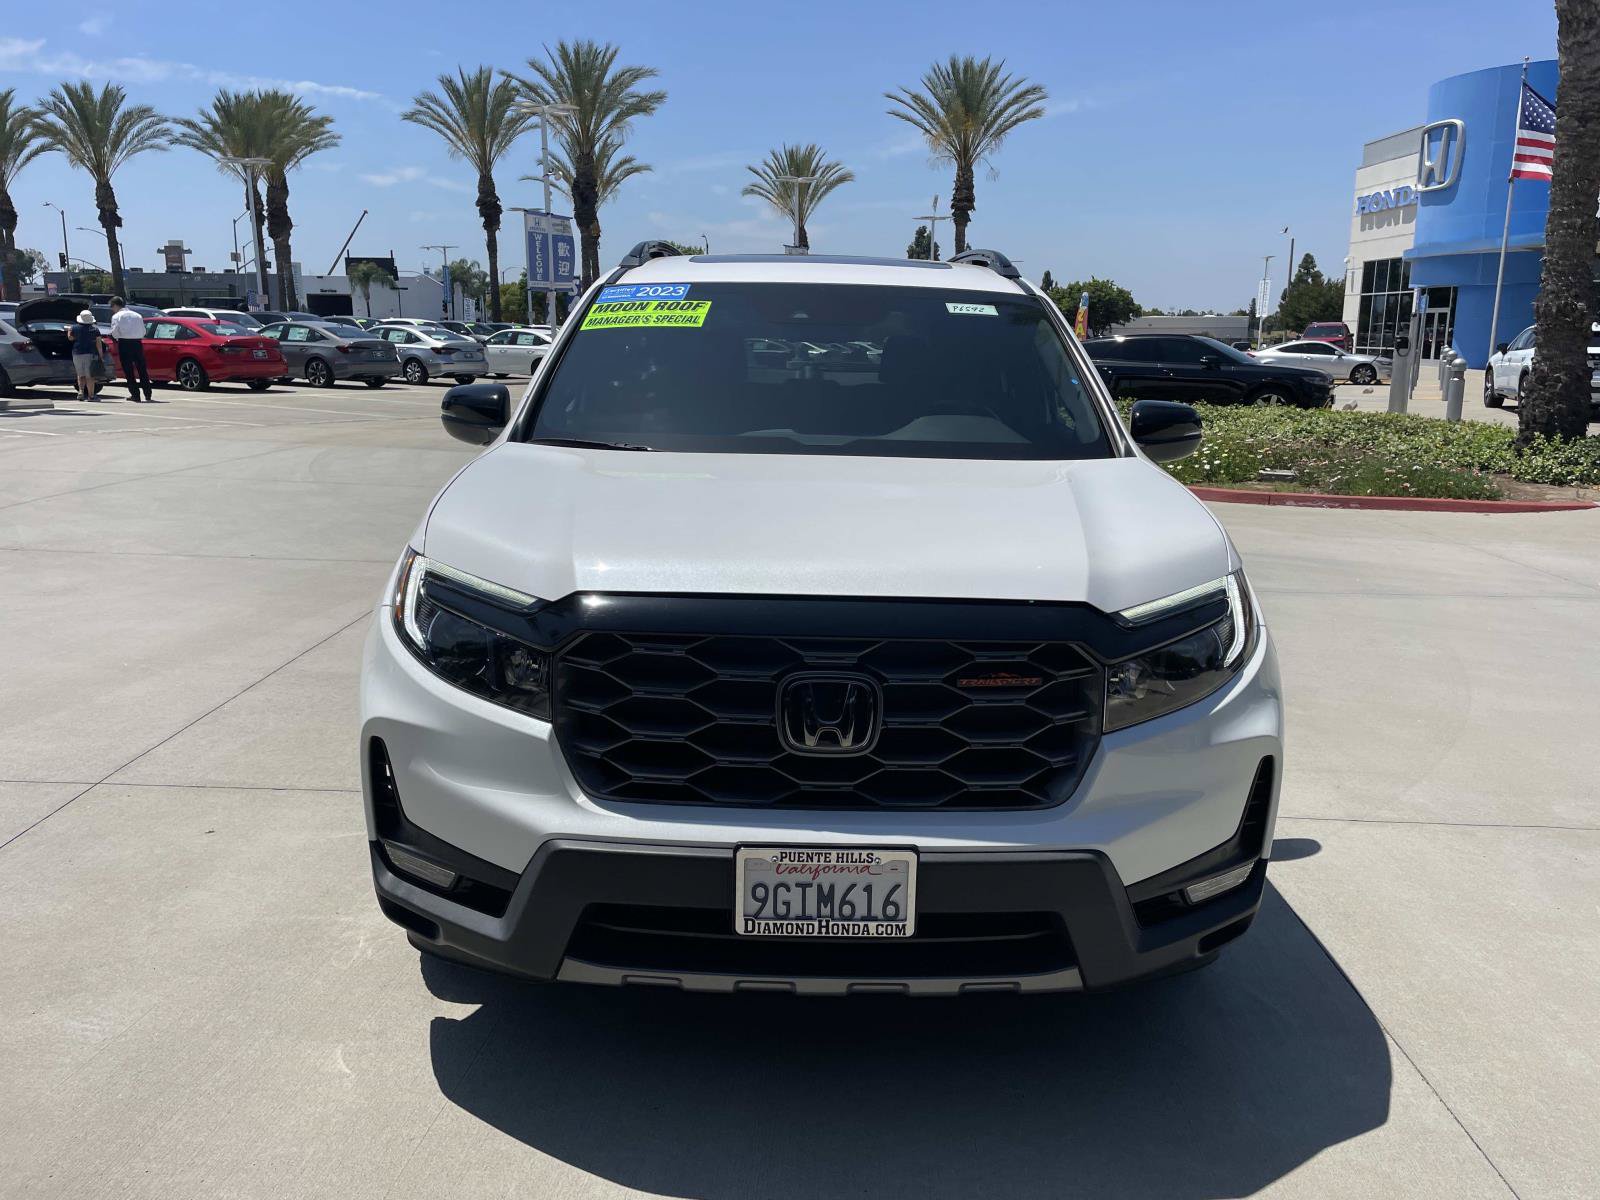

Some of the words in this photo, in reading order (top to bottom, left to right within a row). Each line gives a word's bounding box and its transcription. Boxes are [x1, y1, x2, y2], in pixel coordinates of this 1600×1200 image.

[533, 232, 543, 281] WELCOME
[636, 286, 685, 297] 2023
[593, 302, 647, 314] MOON
[653, 301, 707, 311] ROOF
[586, 315, 651, 326] MANAGER'S
[653, 314, 700, 324] SPECIAL
[779, 851, 832, 864] PUENTE
[835, 852, 874, 864] HILLS
[775, 863, 883, 881] California
